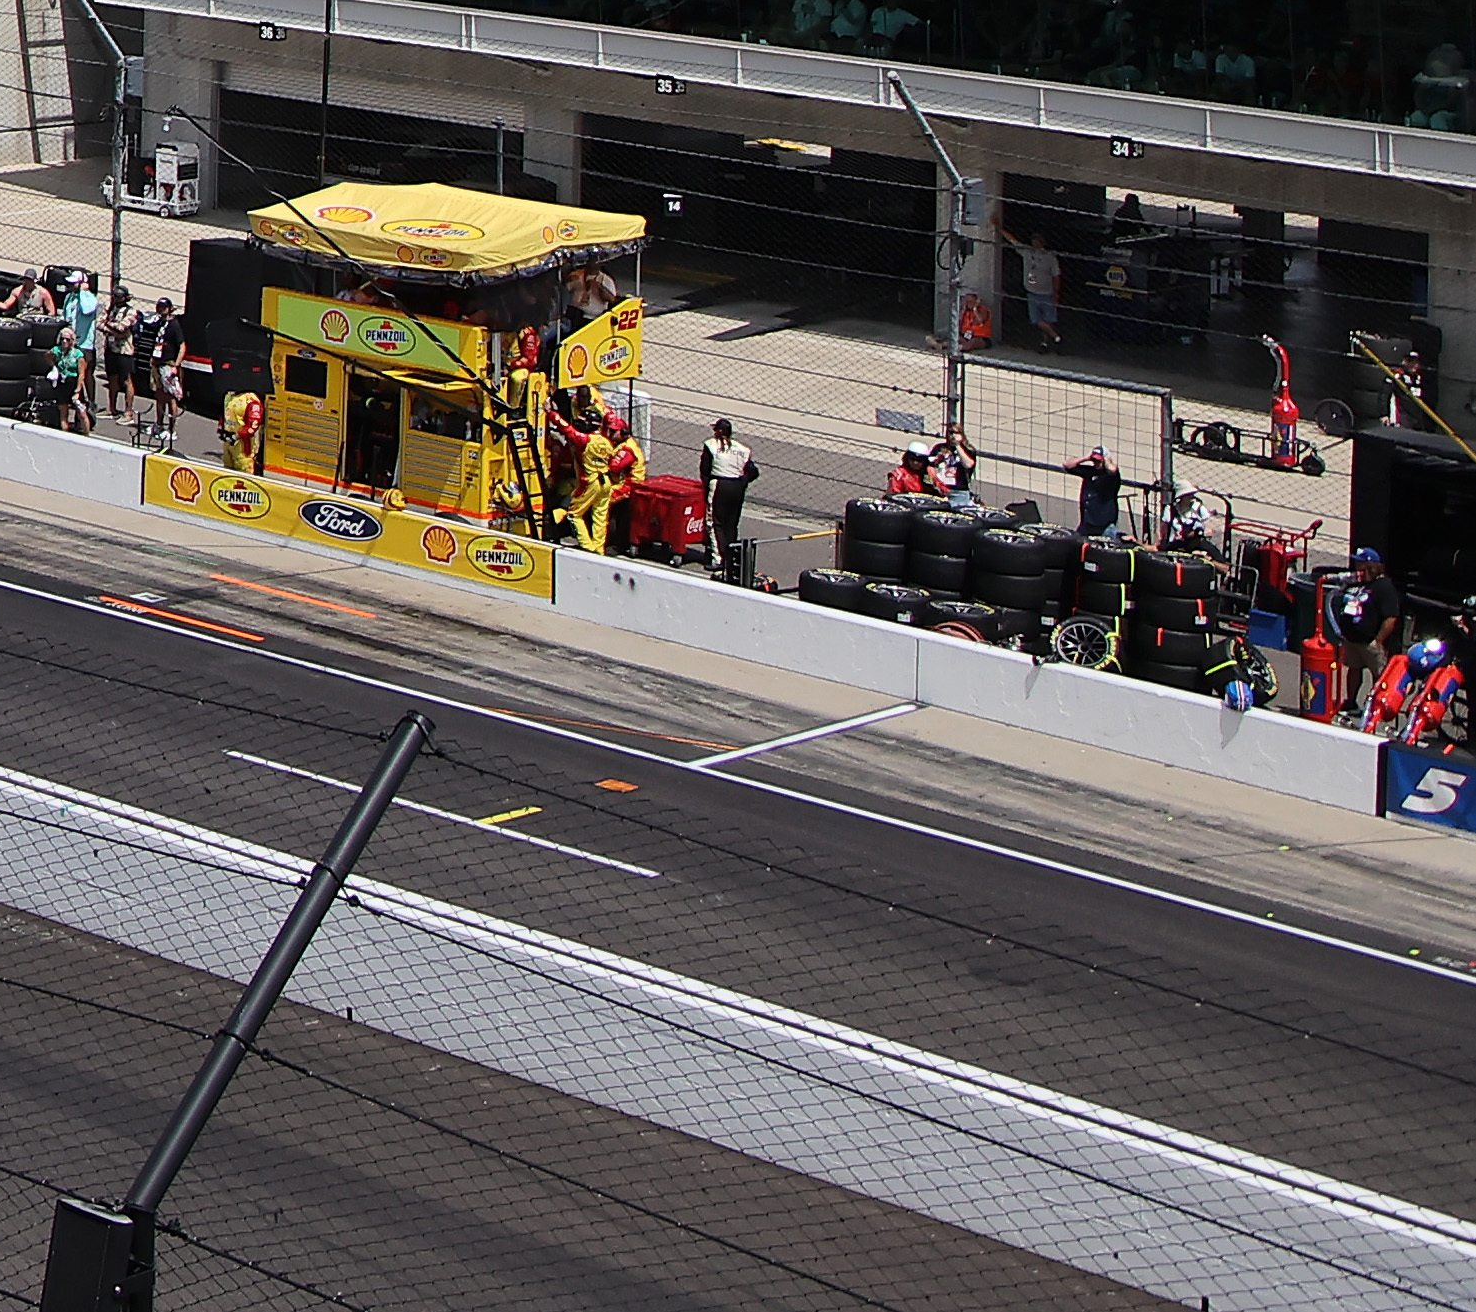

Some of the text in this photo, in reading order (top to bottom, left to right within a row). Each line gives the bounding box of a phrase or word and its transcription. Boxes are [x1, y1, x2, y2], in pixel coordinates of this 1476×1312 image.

[260, 26, 273, 39] 36
[1112, 140, 1130, 158] 34
[667, 200, 681, 212] 14
[393, 223, 470, 239] PENNZOIL
[617, 308, 639, 331] 22
[364, 328, 409, 344] PENNZOIL
[598, 346, 630, 367] PENNZOIL
[217, 488, 265, 506] PENNZOIL
[314, 504, 366, 537] Ford
[475, 548, 527, 568] PENNZOIL
[1400, 766, 1470, 814] 5
